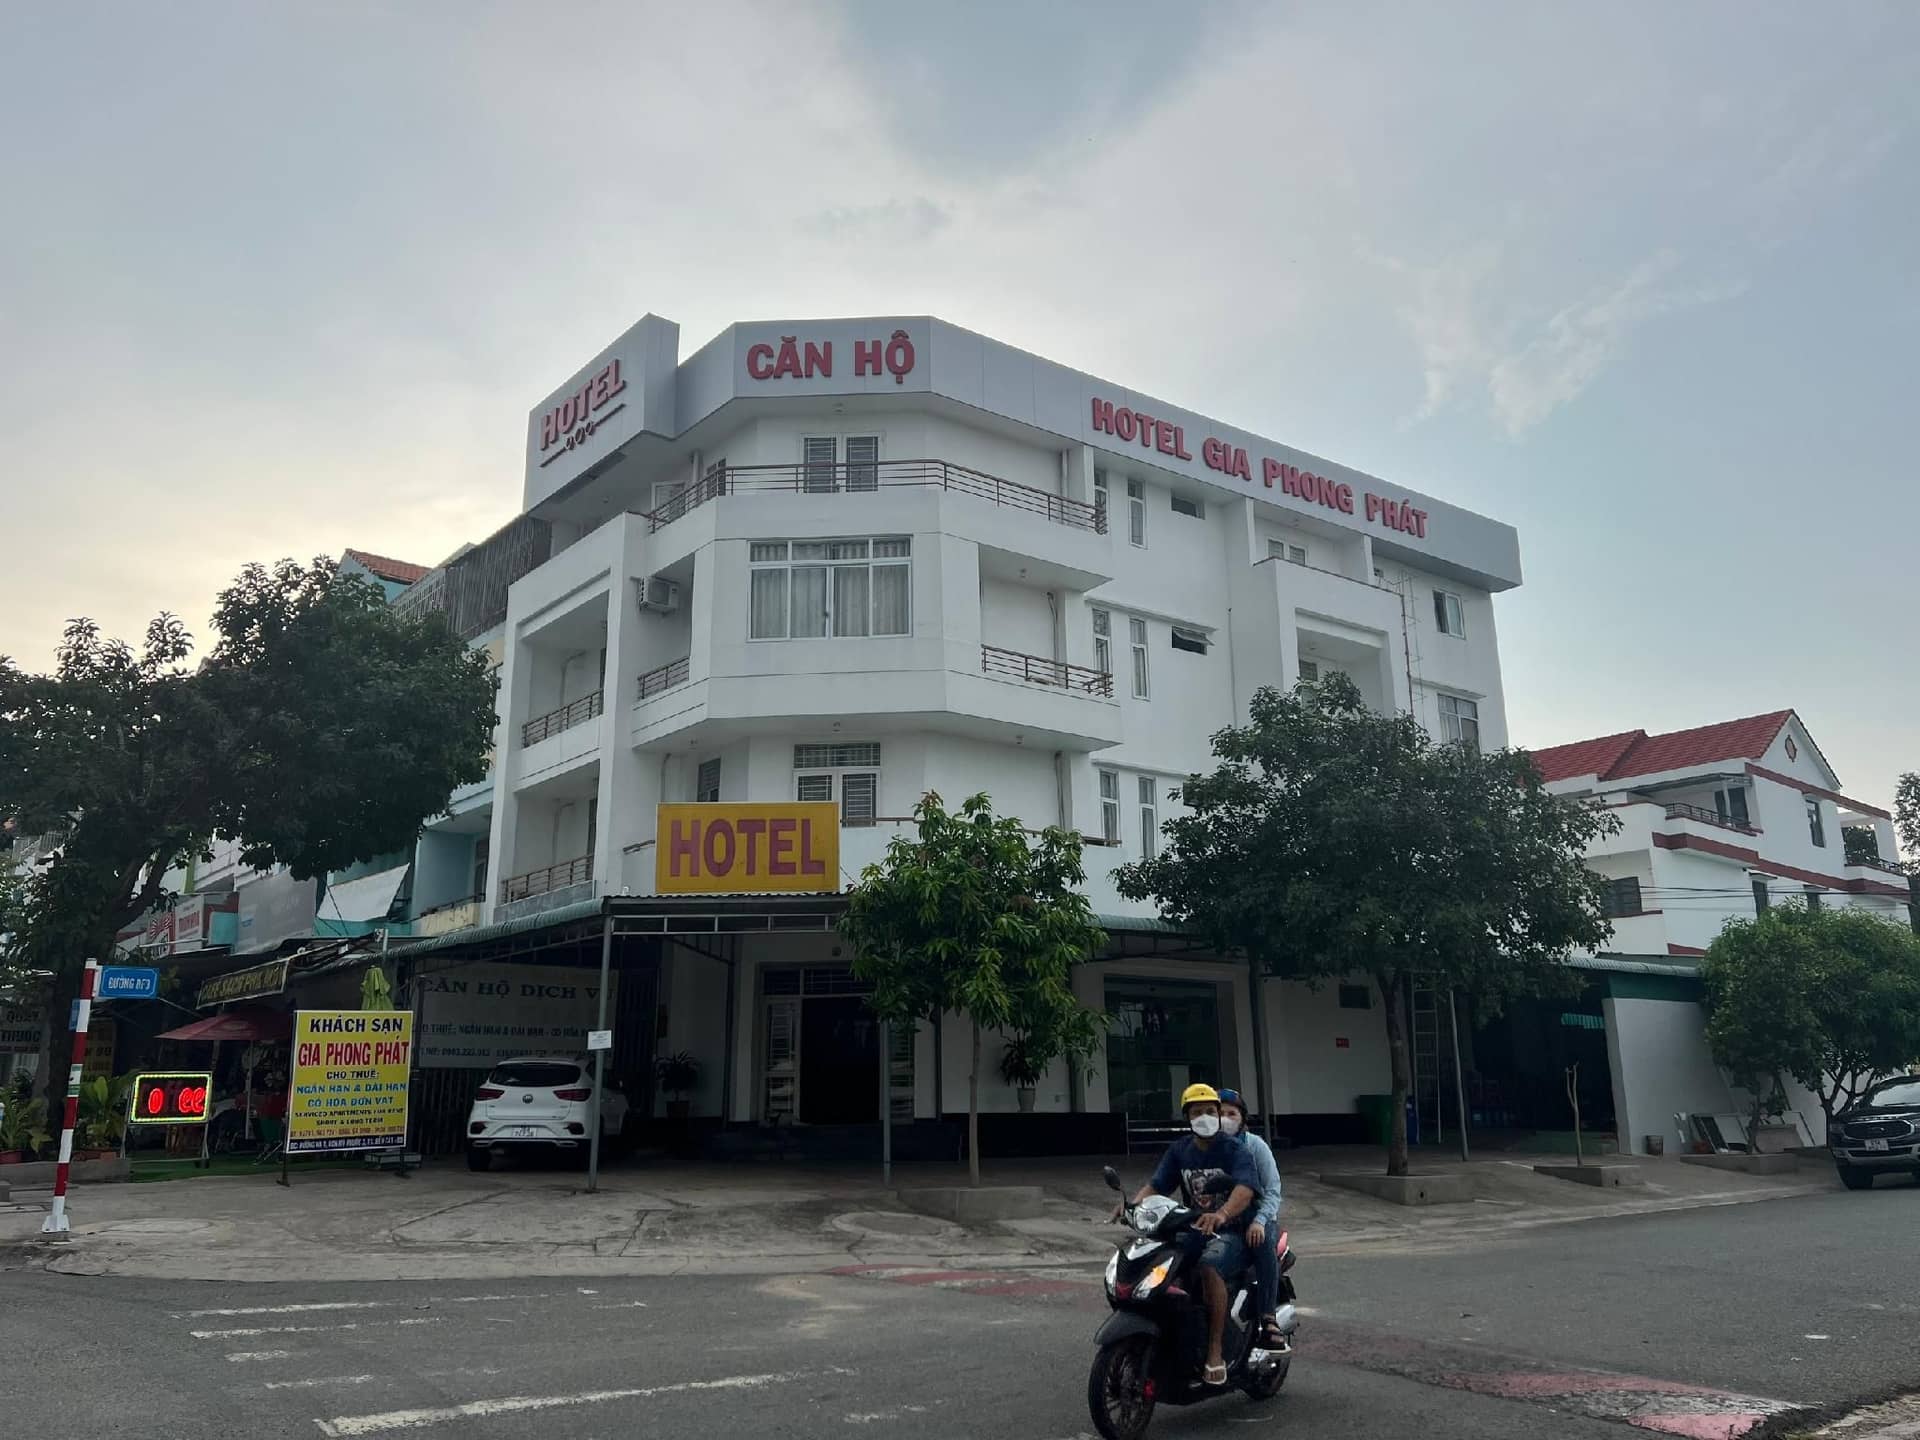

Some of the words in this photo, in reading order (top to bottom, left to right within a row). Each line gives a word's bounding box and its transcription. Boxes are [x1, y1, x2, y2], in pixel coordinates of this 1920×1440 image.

[746, 335, 832, 380] CĂN
[854, 329, 915, 385] HỘ
[540, 358, 627, 452] HOTEL
[1092, 397, 1193, 462] HOTEL
[1203, 437, 1252, 481] GIA
[1263, 457, 1355, 515] PHONG
[1364, 492, 1428, 539] PHÁT
[669, 818, 827, 878] HOTEL
[478, 979, 511, 998] HỘ
[310, 1015, 366, 1033] KHÁCH
[371, 1018, 403, 1036] SẠN
[298, 1042, 321, 1067] GIA
[325, 1042, 371, 1066] PHONG
[374, 1036, 410, 1065] PHÁT
[326, 1071, 347, 1080] CHO
